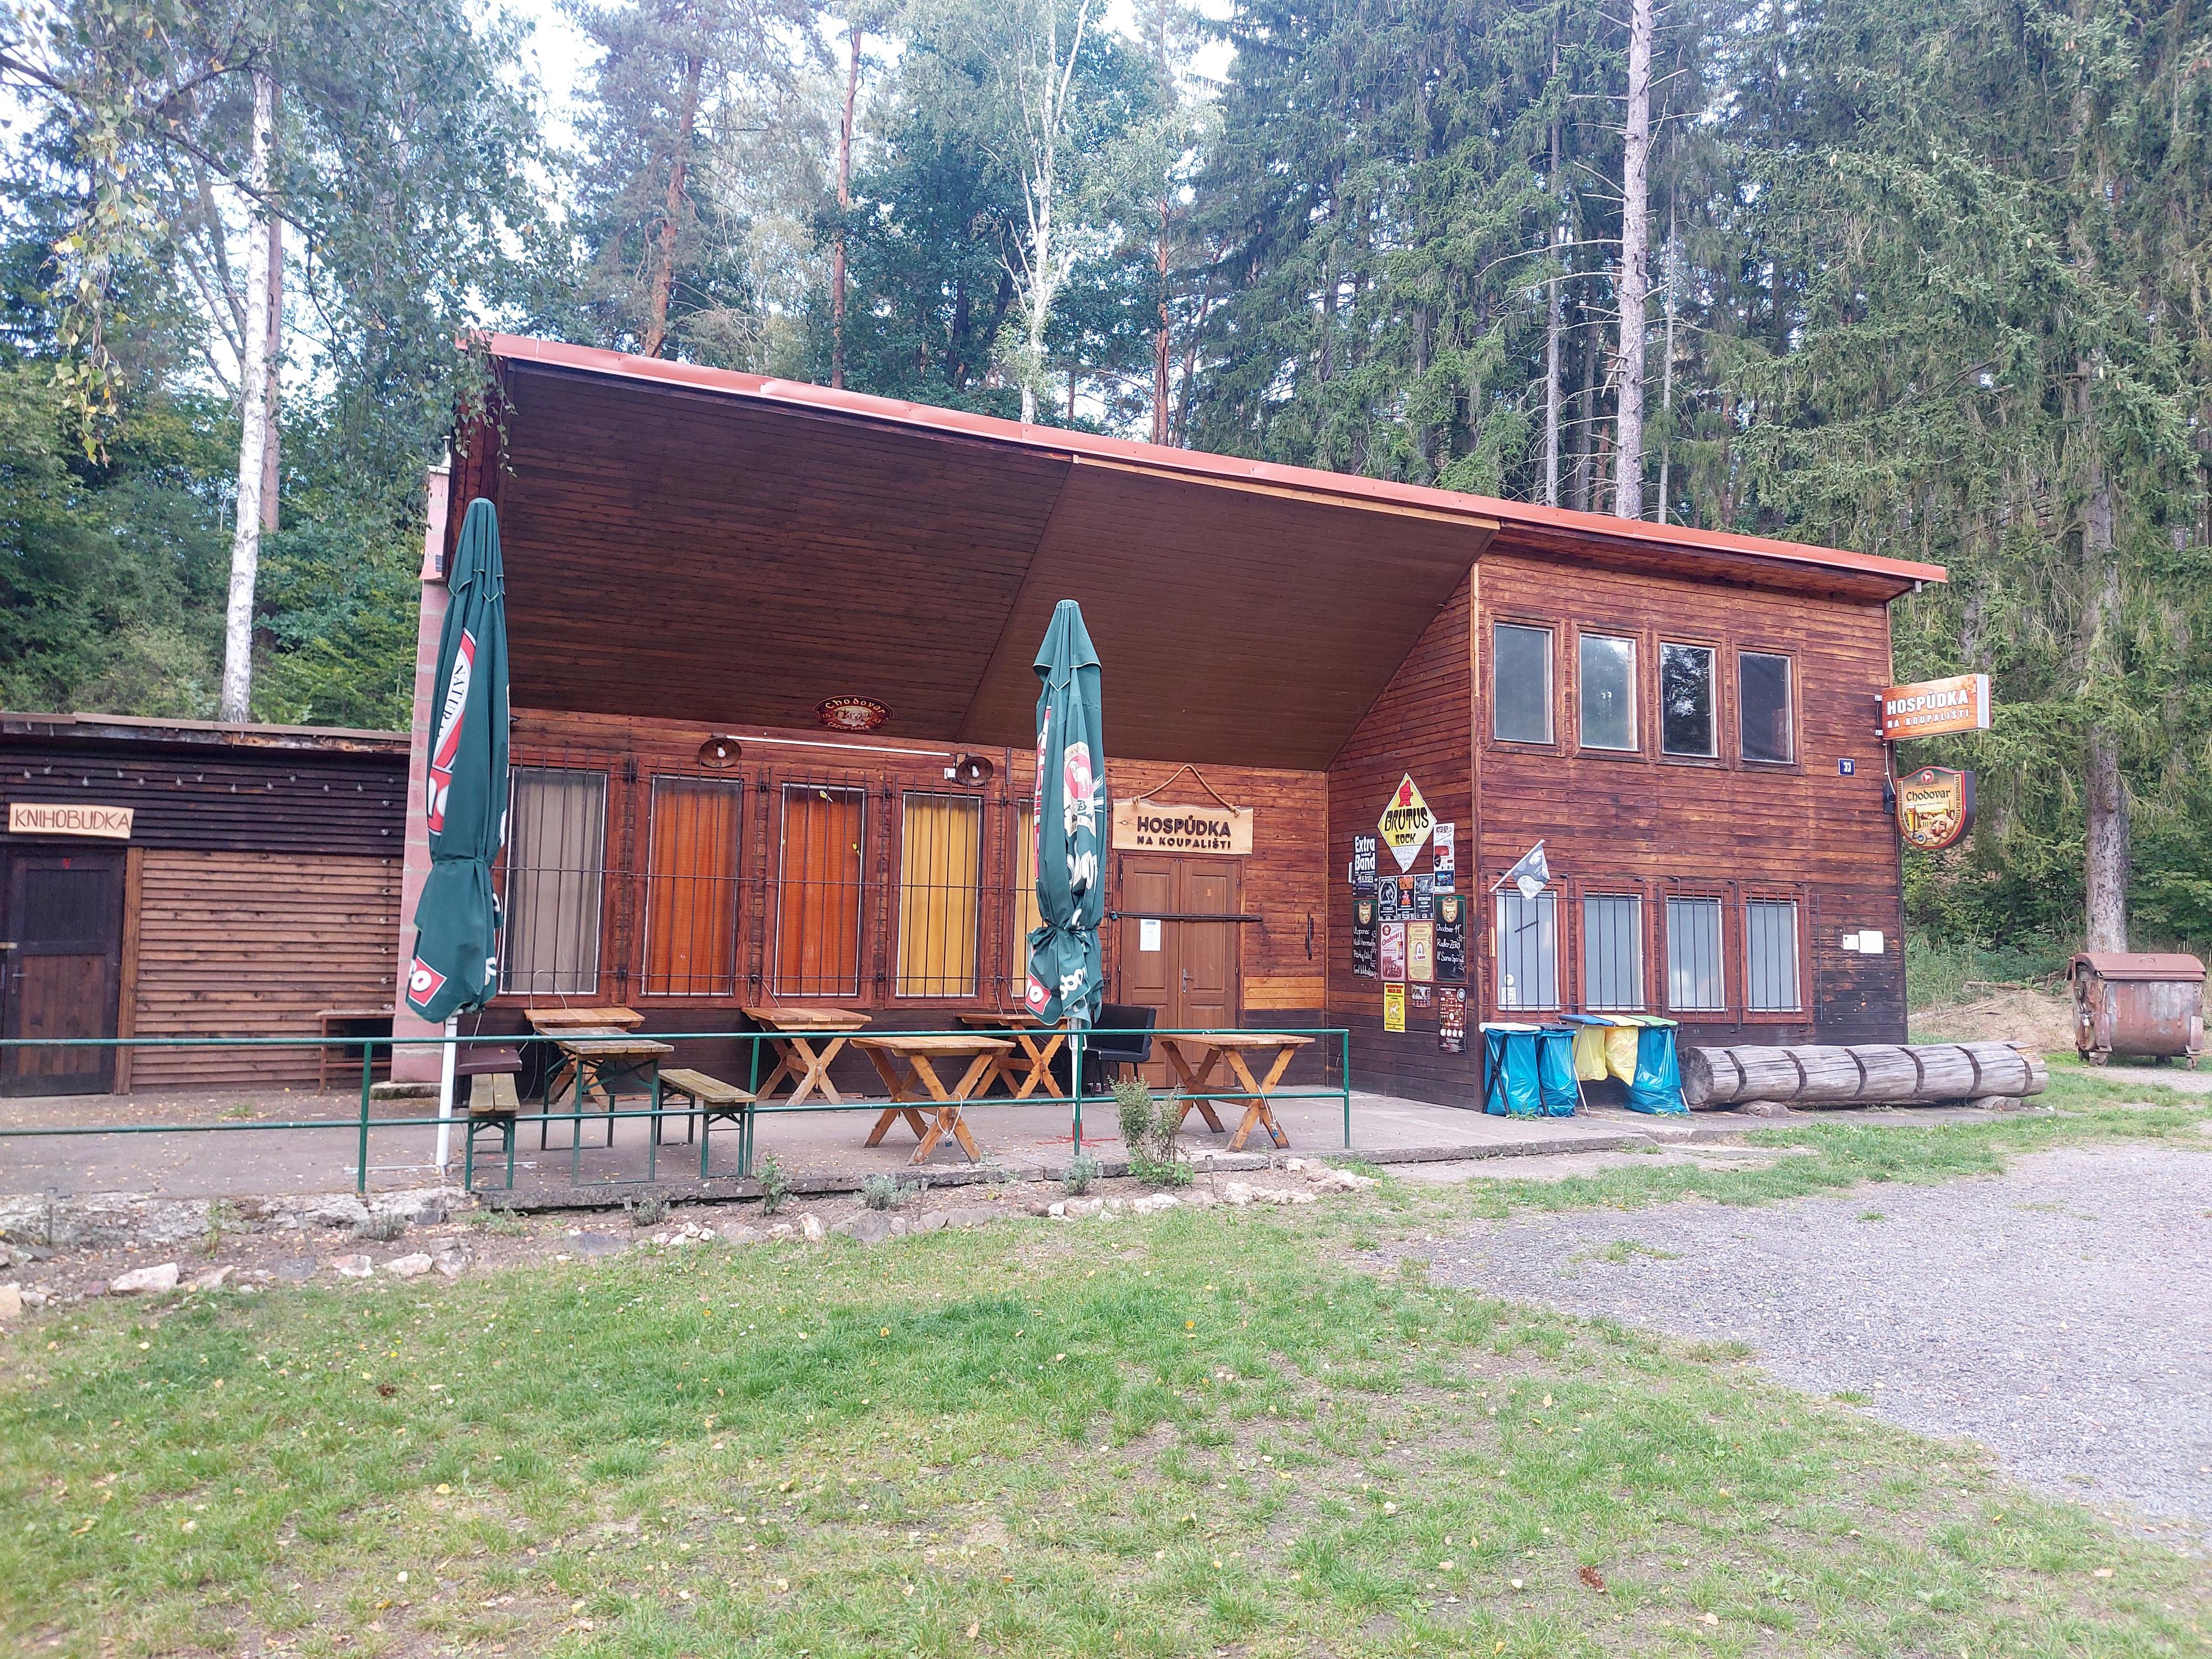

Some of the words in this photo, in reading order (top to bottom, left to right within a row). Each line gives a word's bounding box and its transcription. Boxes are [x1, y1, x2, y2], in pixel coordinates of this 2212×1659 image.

[439, 665, 465, 738] NATUR
[825, 698, 885, 714] Chodovar
[1887, 690, 1969, 716] HOSPŮDKA
[827, 722, 848, 730] CZECH
[1887, 719, 1900, 728] NA
[1906, 708, 1970, 726] KOUPALIŠTI
[1844, 761, 1851, 773] 33
[1906, 789, 1950, 802] Chodovar
[15, 809, 131, 831] KNIHOBUDKA
[1137, 815, 1232, 837] HOSPŮDKA
[1385, 807, 1429, 832] BRUTUS
[1137, 836, 1154, 846] NA
[1159, 837, 1232, 849] KOUPALIŠTI
[1355, 836, 1375, 853] Extra
[1395, 833, 1416, 845] ROCK
[1355, 852, 1375, 871] Band
[1383, 932, 1400, 946] Chodovar
[1437, 938, 1449, 947] Radler
[1449, 940, 1460, 949] ZERO
[1441, 951, 1452, 961] Sano
